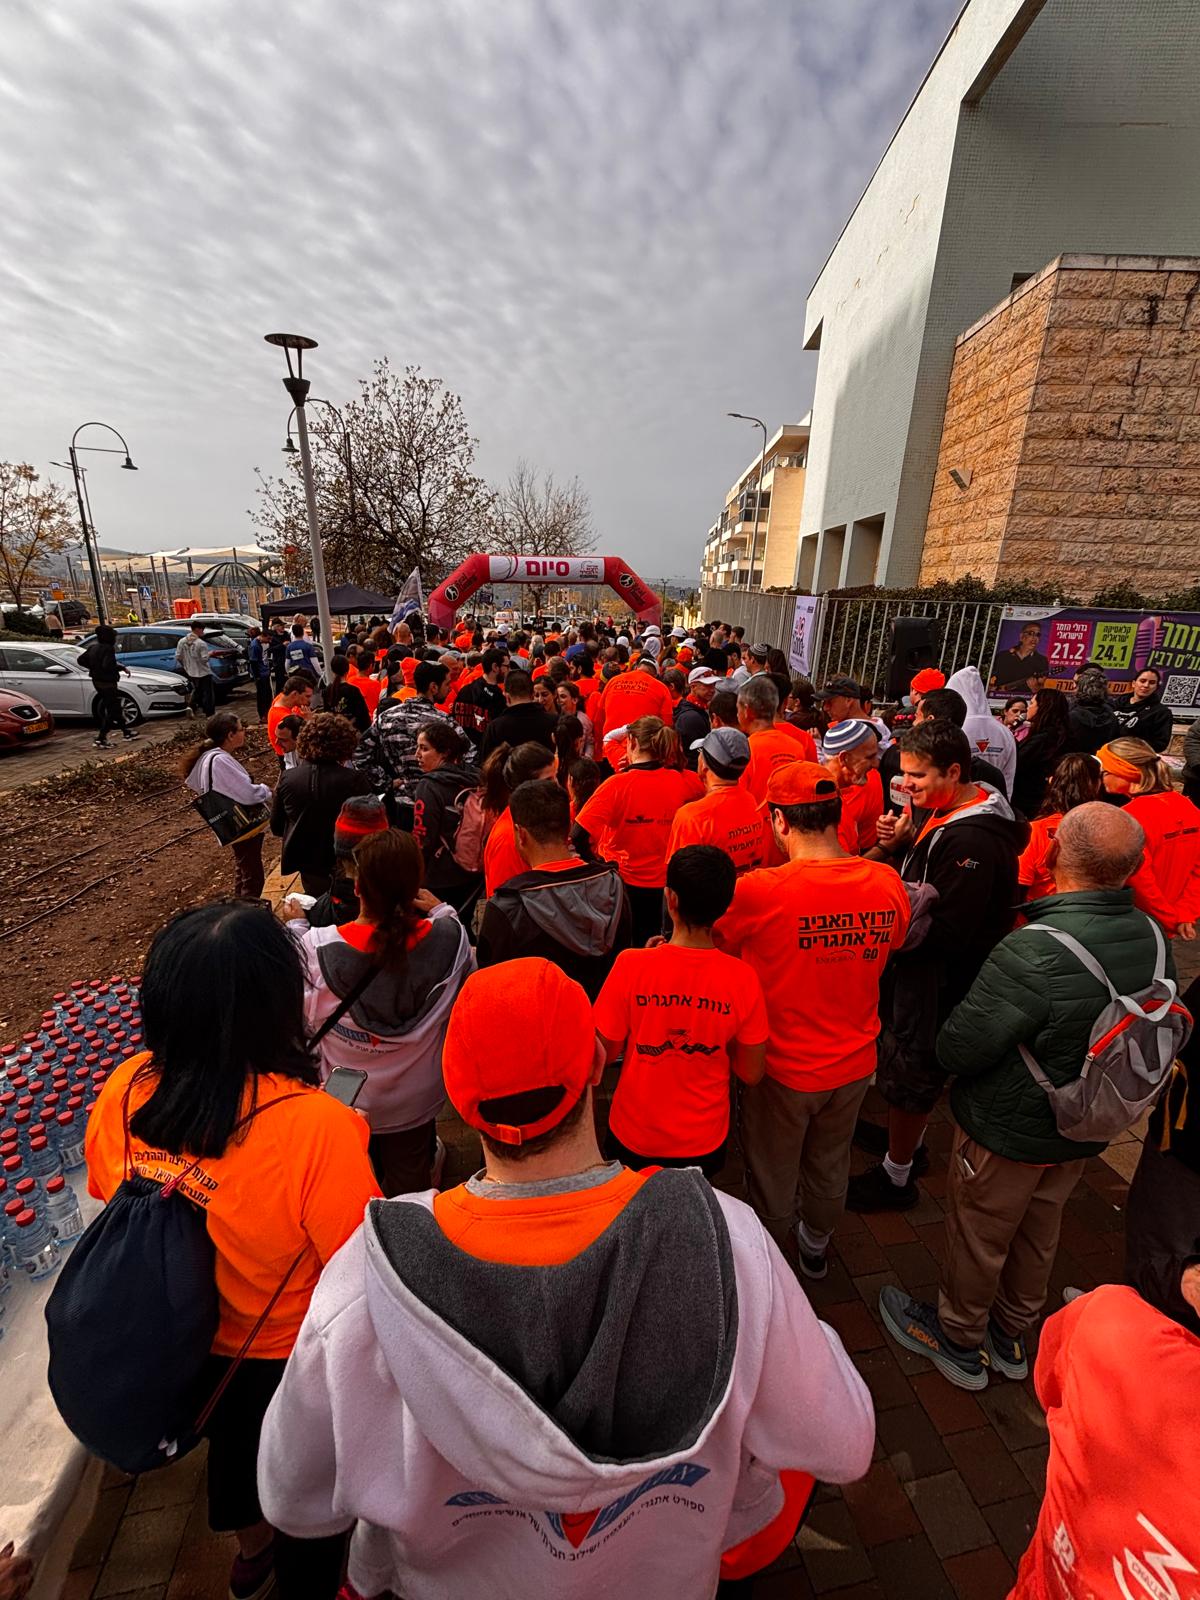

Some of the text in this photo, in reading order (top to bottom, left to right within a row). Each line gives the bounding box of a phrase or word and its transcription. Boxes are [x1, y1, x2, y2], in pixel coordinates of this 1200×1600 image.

[525, 561, 569, 576] סיום
[1056, 623, 1072, 631] הזמר
[1057, 631, 1083, 640] הישראלי
[1162, 622, 1200, 651] זמר
[1051, 642, 1085, 660] 21.2
[1095, 644, 1128, 661] 24.1
[1147, 649, 1174, 667] רבין
[798, 910, 896, 930] מרוץ האביב
[799, 930, 890, 949] של אתגרים
[636, 994, 731, 1015] צוות אתגרים
[192, 1166, 219, 1190] קבוצת
[180, 1182, 211, 1206] אתגרים
[907, 1323, 940, 1351] HOKA
[673, 1494, 705, 1513] ספורט
[495, 1509, 526, 1518] אנשים
[528, 1512, 540, 1532] של
[569, 1541, 601, 1561] ושילוב
